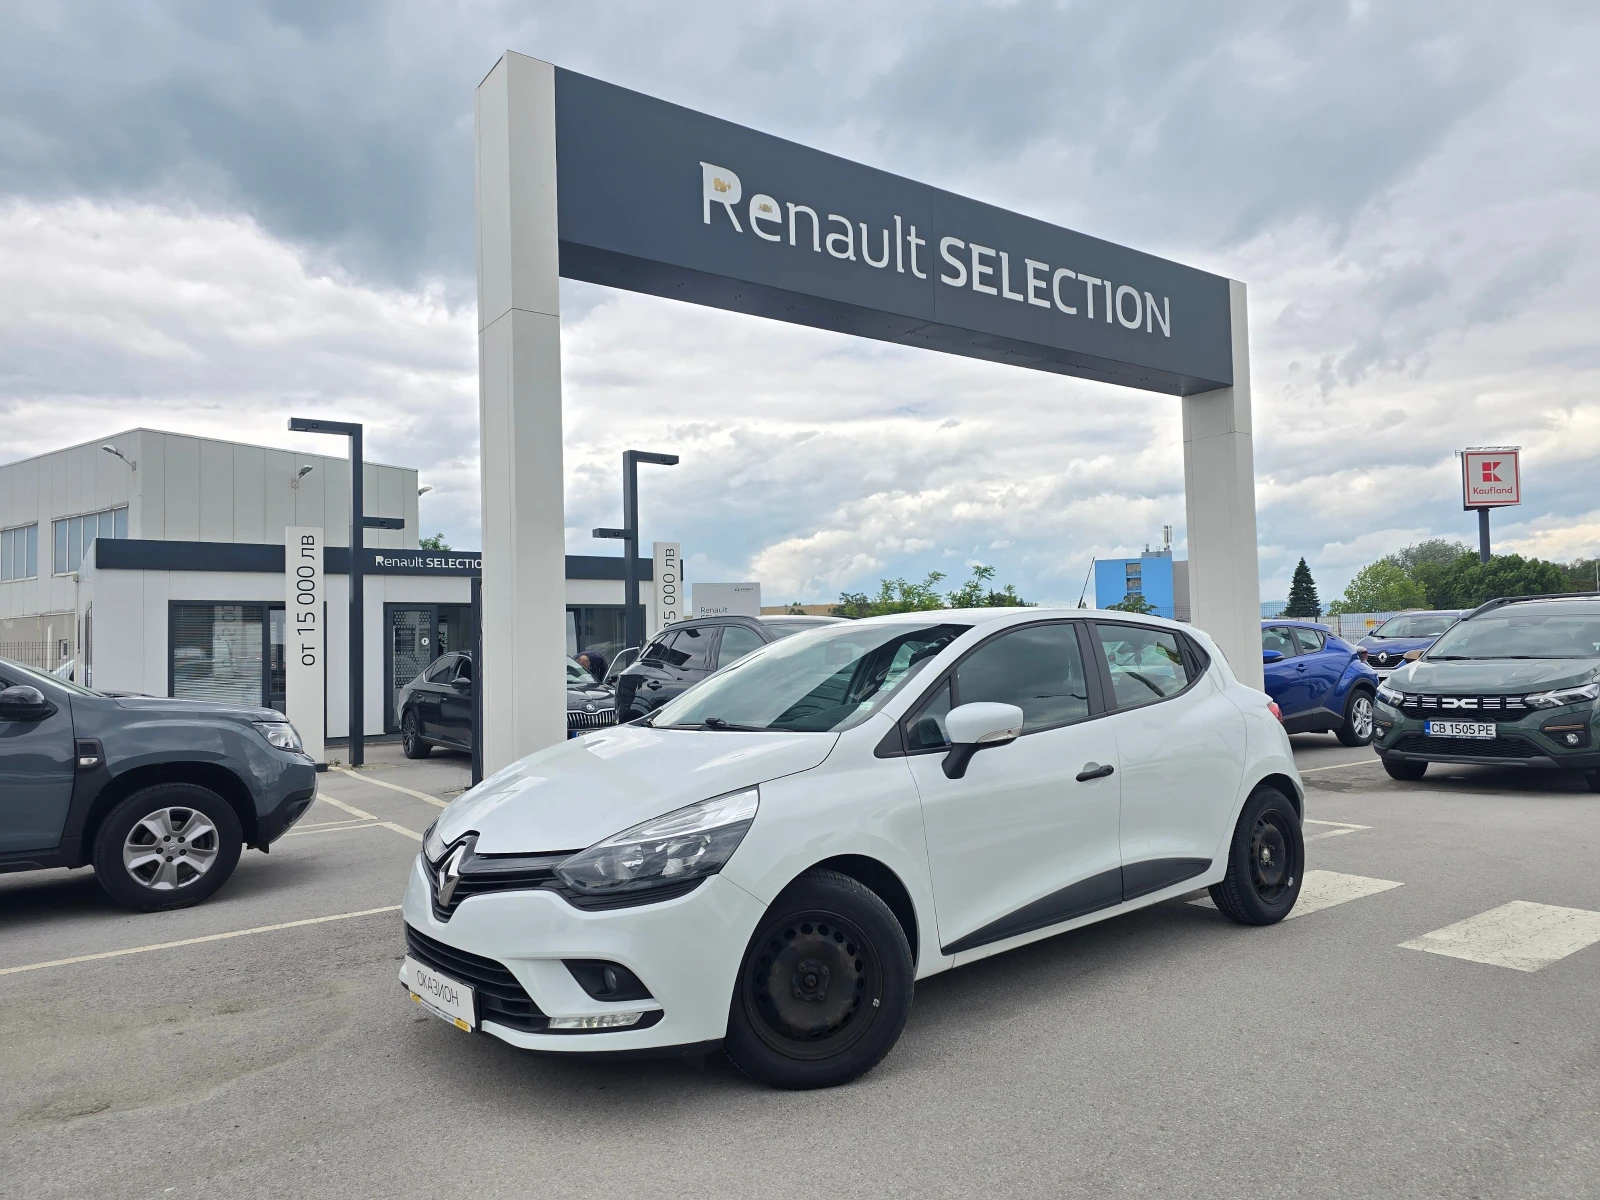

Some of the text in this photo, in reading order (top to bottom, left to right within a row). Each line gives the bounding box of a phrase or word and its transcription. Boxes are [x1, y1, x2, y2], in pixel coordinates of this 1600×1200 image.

[700, 161, 1171, 338] Renault SELECTION
[1473, 486, 1513, 495] Kaufland
[375, 555, 424, 568] Renault
[296, 565, 315, 605] 000
[662, 573, 676, 605] 000
[700, 606, 728, 614] Renault
[296, 612, 315, 636] 15
[1450, 723, 1476, 735] 1505
[416, 969, 460, 1007] ОКАЗИОН
